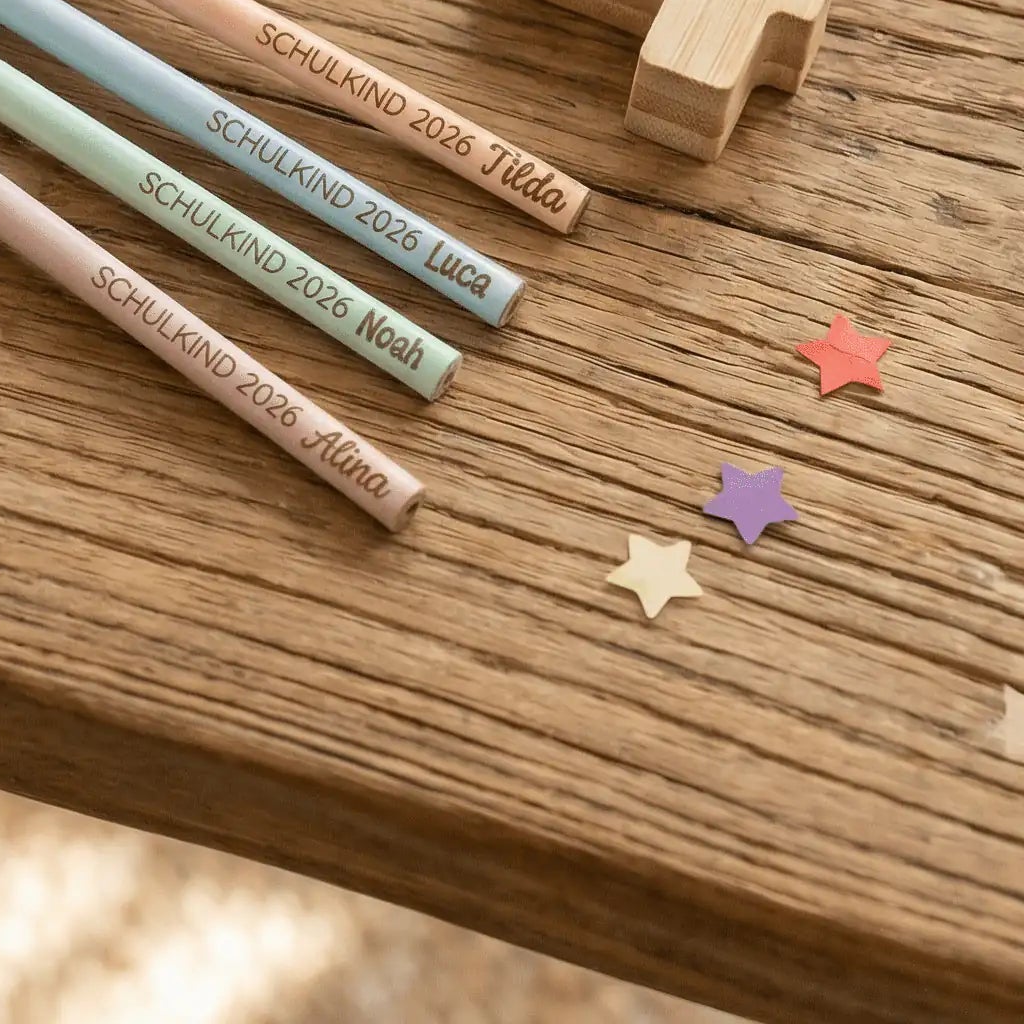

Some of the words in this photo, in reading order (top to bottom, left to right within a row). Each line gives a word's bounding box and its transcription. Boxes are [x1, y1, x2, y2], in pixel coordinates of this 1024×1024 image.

[206, 109, 355, 209] SCHULKIND
[355, 202, 420, 252] 2026
[424, 239, 493, 299] Luca
[255, 23, 408, 116] SCHULKIND
[410, 108, 476, 157] 2026
[480, 142, 569, 215] Tilda
[138, 171, 288, 274] SCHULKIND
[287, 266, 354, 318] 2026
[355, 308, 425, 371] Noah
[91, 266, 238, 378] SCHULKIND
[236, 373, 303, 427] 2026
[301, 430, 390, 500] Alina
